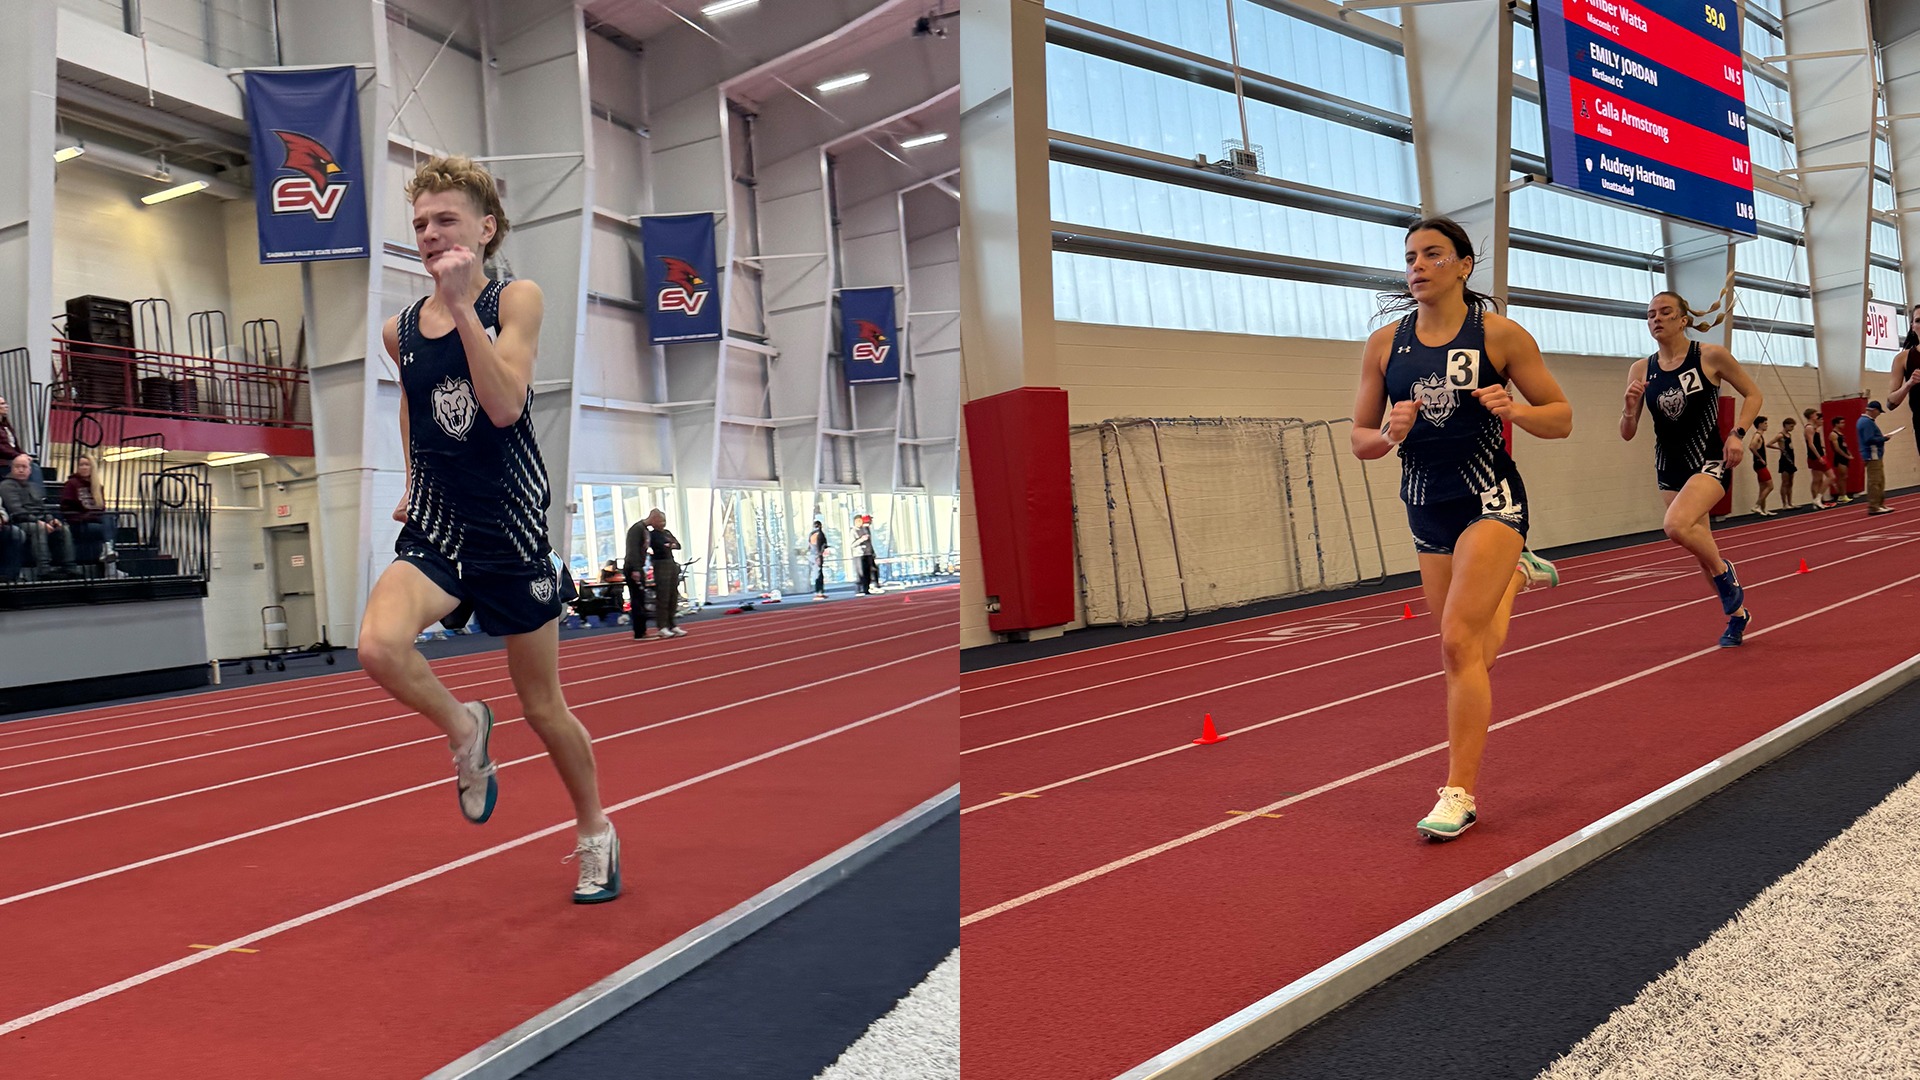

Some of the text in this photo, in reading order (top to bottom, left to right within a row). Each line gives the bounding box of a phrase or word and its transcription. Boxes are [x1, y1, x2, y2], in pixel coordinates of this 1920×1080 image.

[1585, 0, 1648, 33] mber Watta
[1587, 12, 1620, 36] Macomb CC
[1705, 4, 1726, 31] 59.0
[1589, 41, 1658, 87] EMILY JORDAN
[1723, 64, 1742, 86] LN 5
[1615, 78, 1624, 89] CC
[1595, 98, 1670, 144] Calla Armstrong
[1597, 123, 1612, 137] Alma
[1727, 110, 1746, 131] LN 6
[1600, 153, 1676, 191] Audrey Hartman
[1732, 156, 1749, 175] LN 7
[1601, 178, 1635, 197] Unattached
[1736, 201, 1754, 220] LN 8
[1450, 351, 1473, 386] 3
[1682, 371, 1700, 393] 2
[1704, 461, 1720, 475] 2
[1485, 483, 1507, 511] 3
